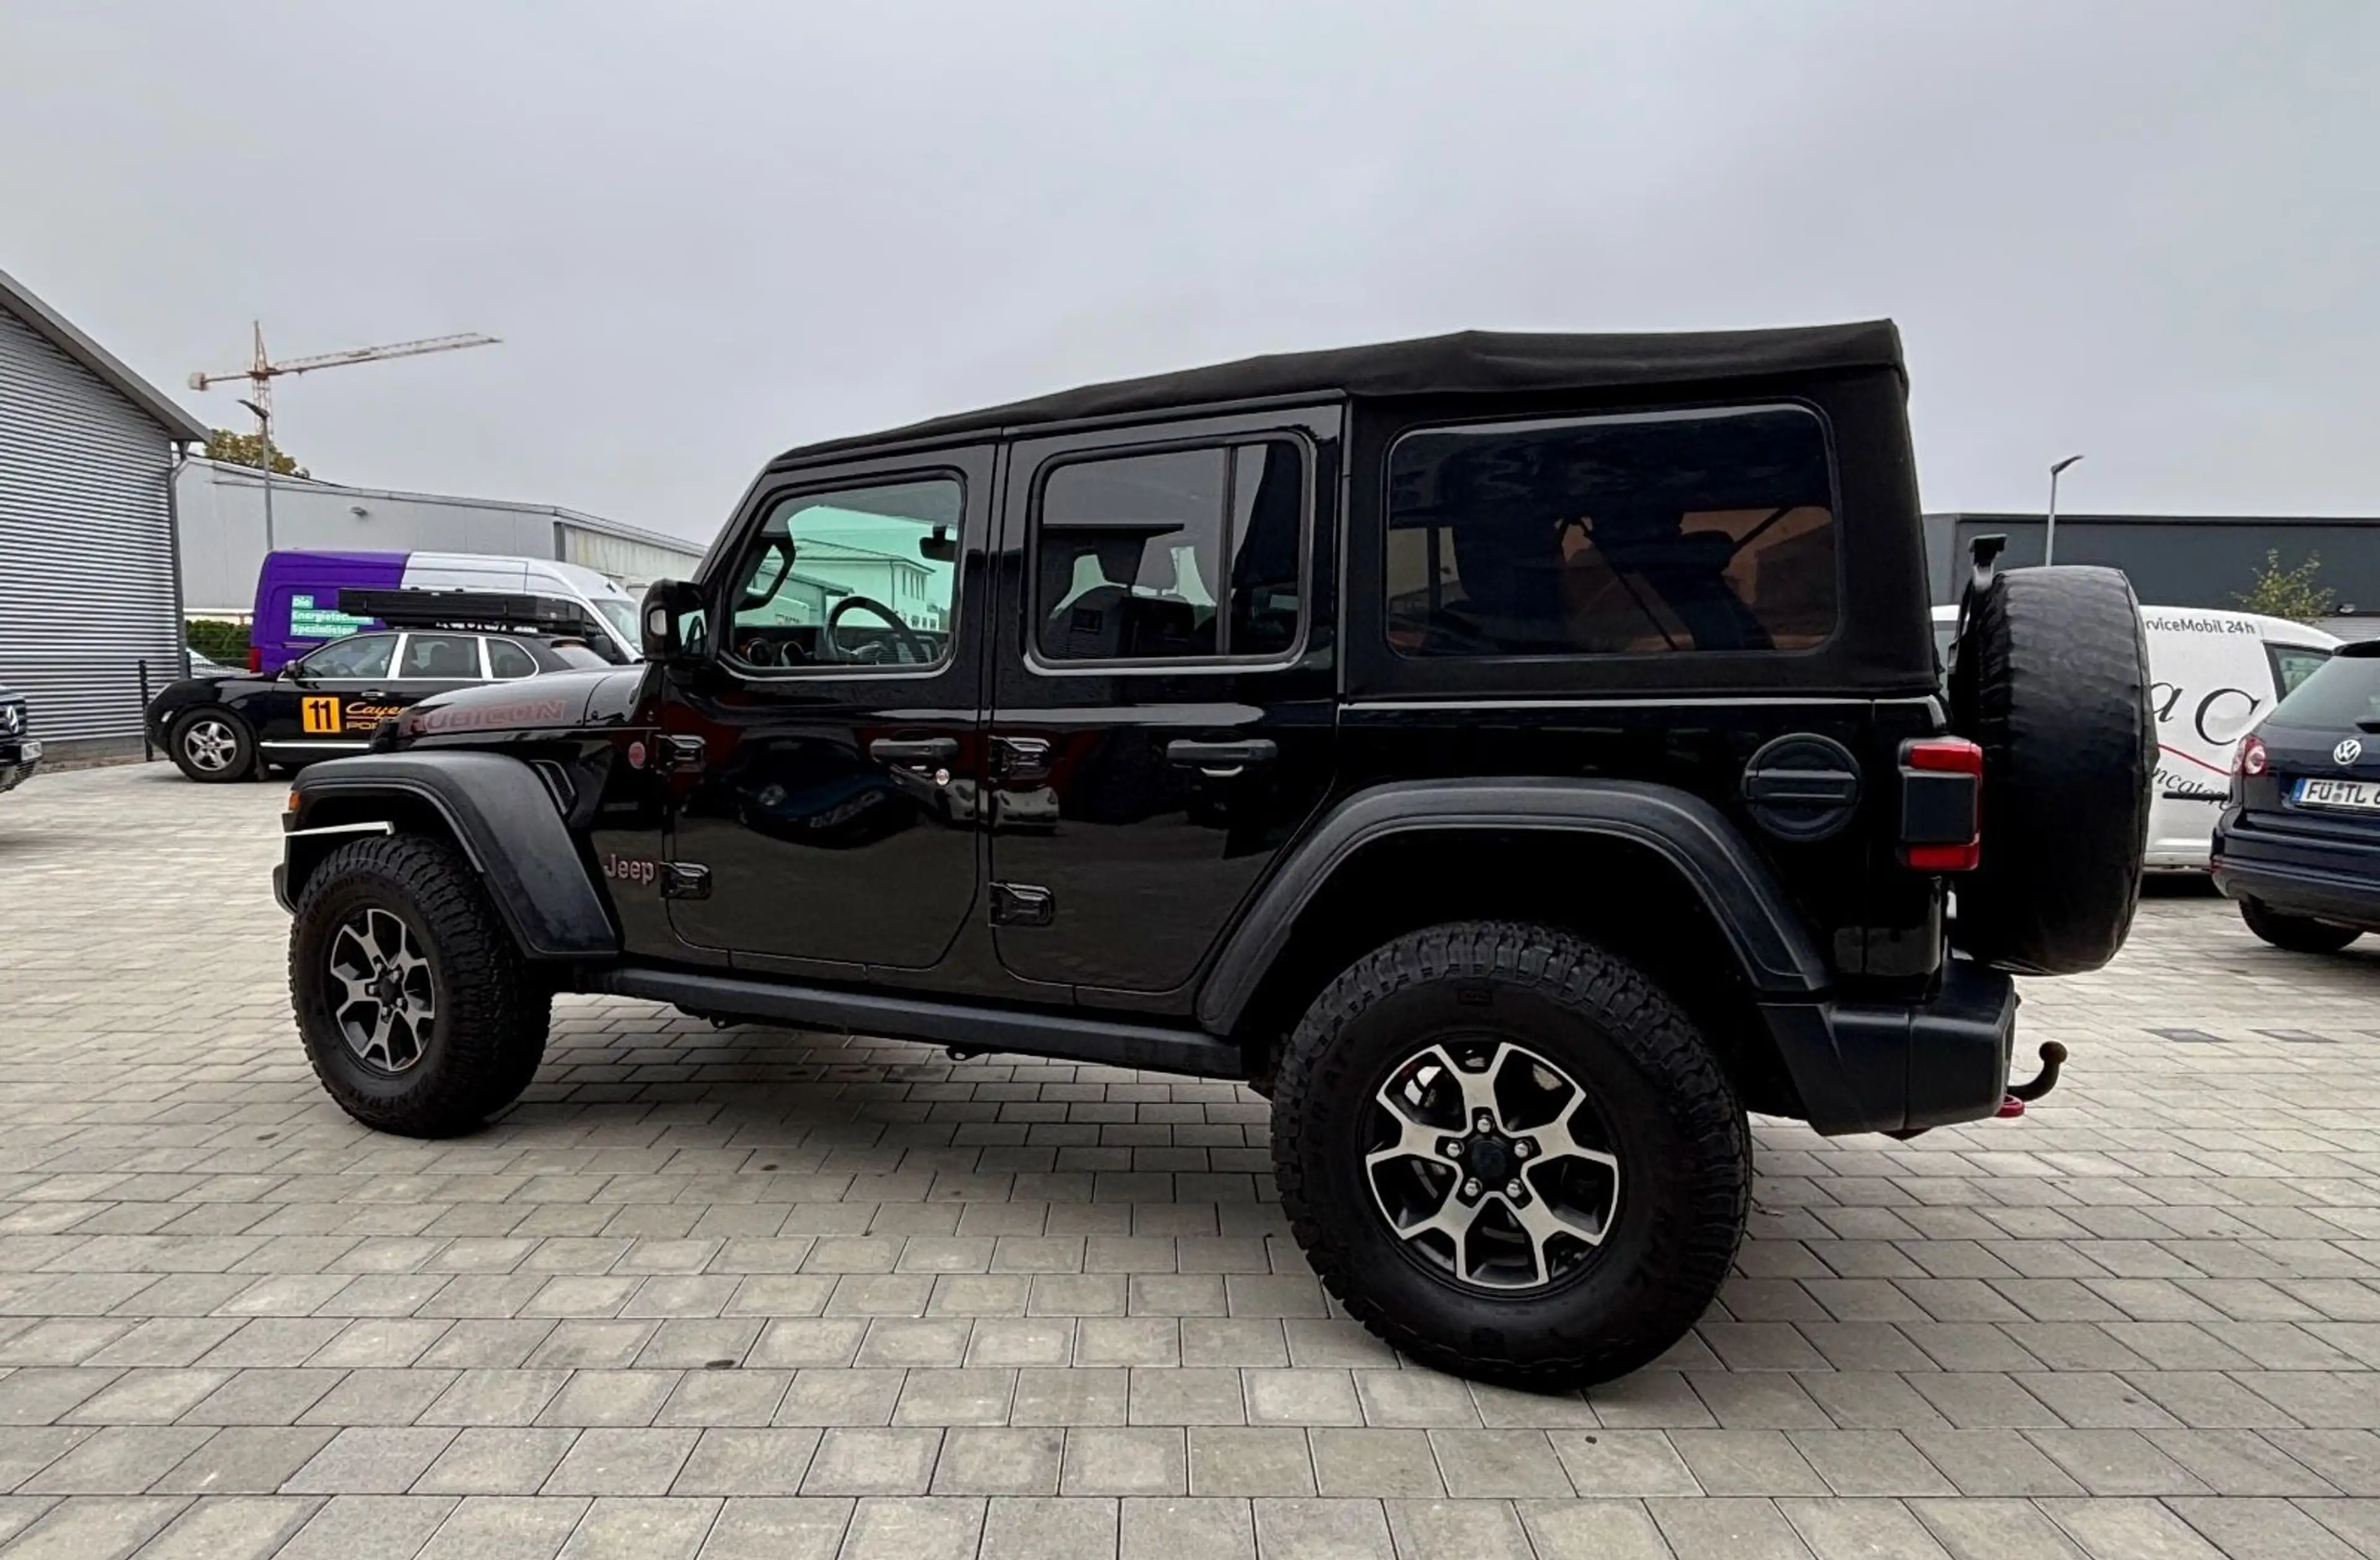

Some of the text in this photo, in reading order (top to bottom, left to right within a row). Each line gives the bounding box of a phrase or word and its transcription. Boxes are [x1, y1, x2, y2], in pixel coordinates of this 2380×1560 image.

[309, 700, 332, 729] 11
[2306, 782, 2334, 800] FÜ
[2345, 784, 2367, 803] TL
[603, 854, 654, 885] Jeep
